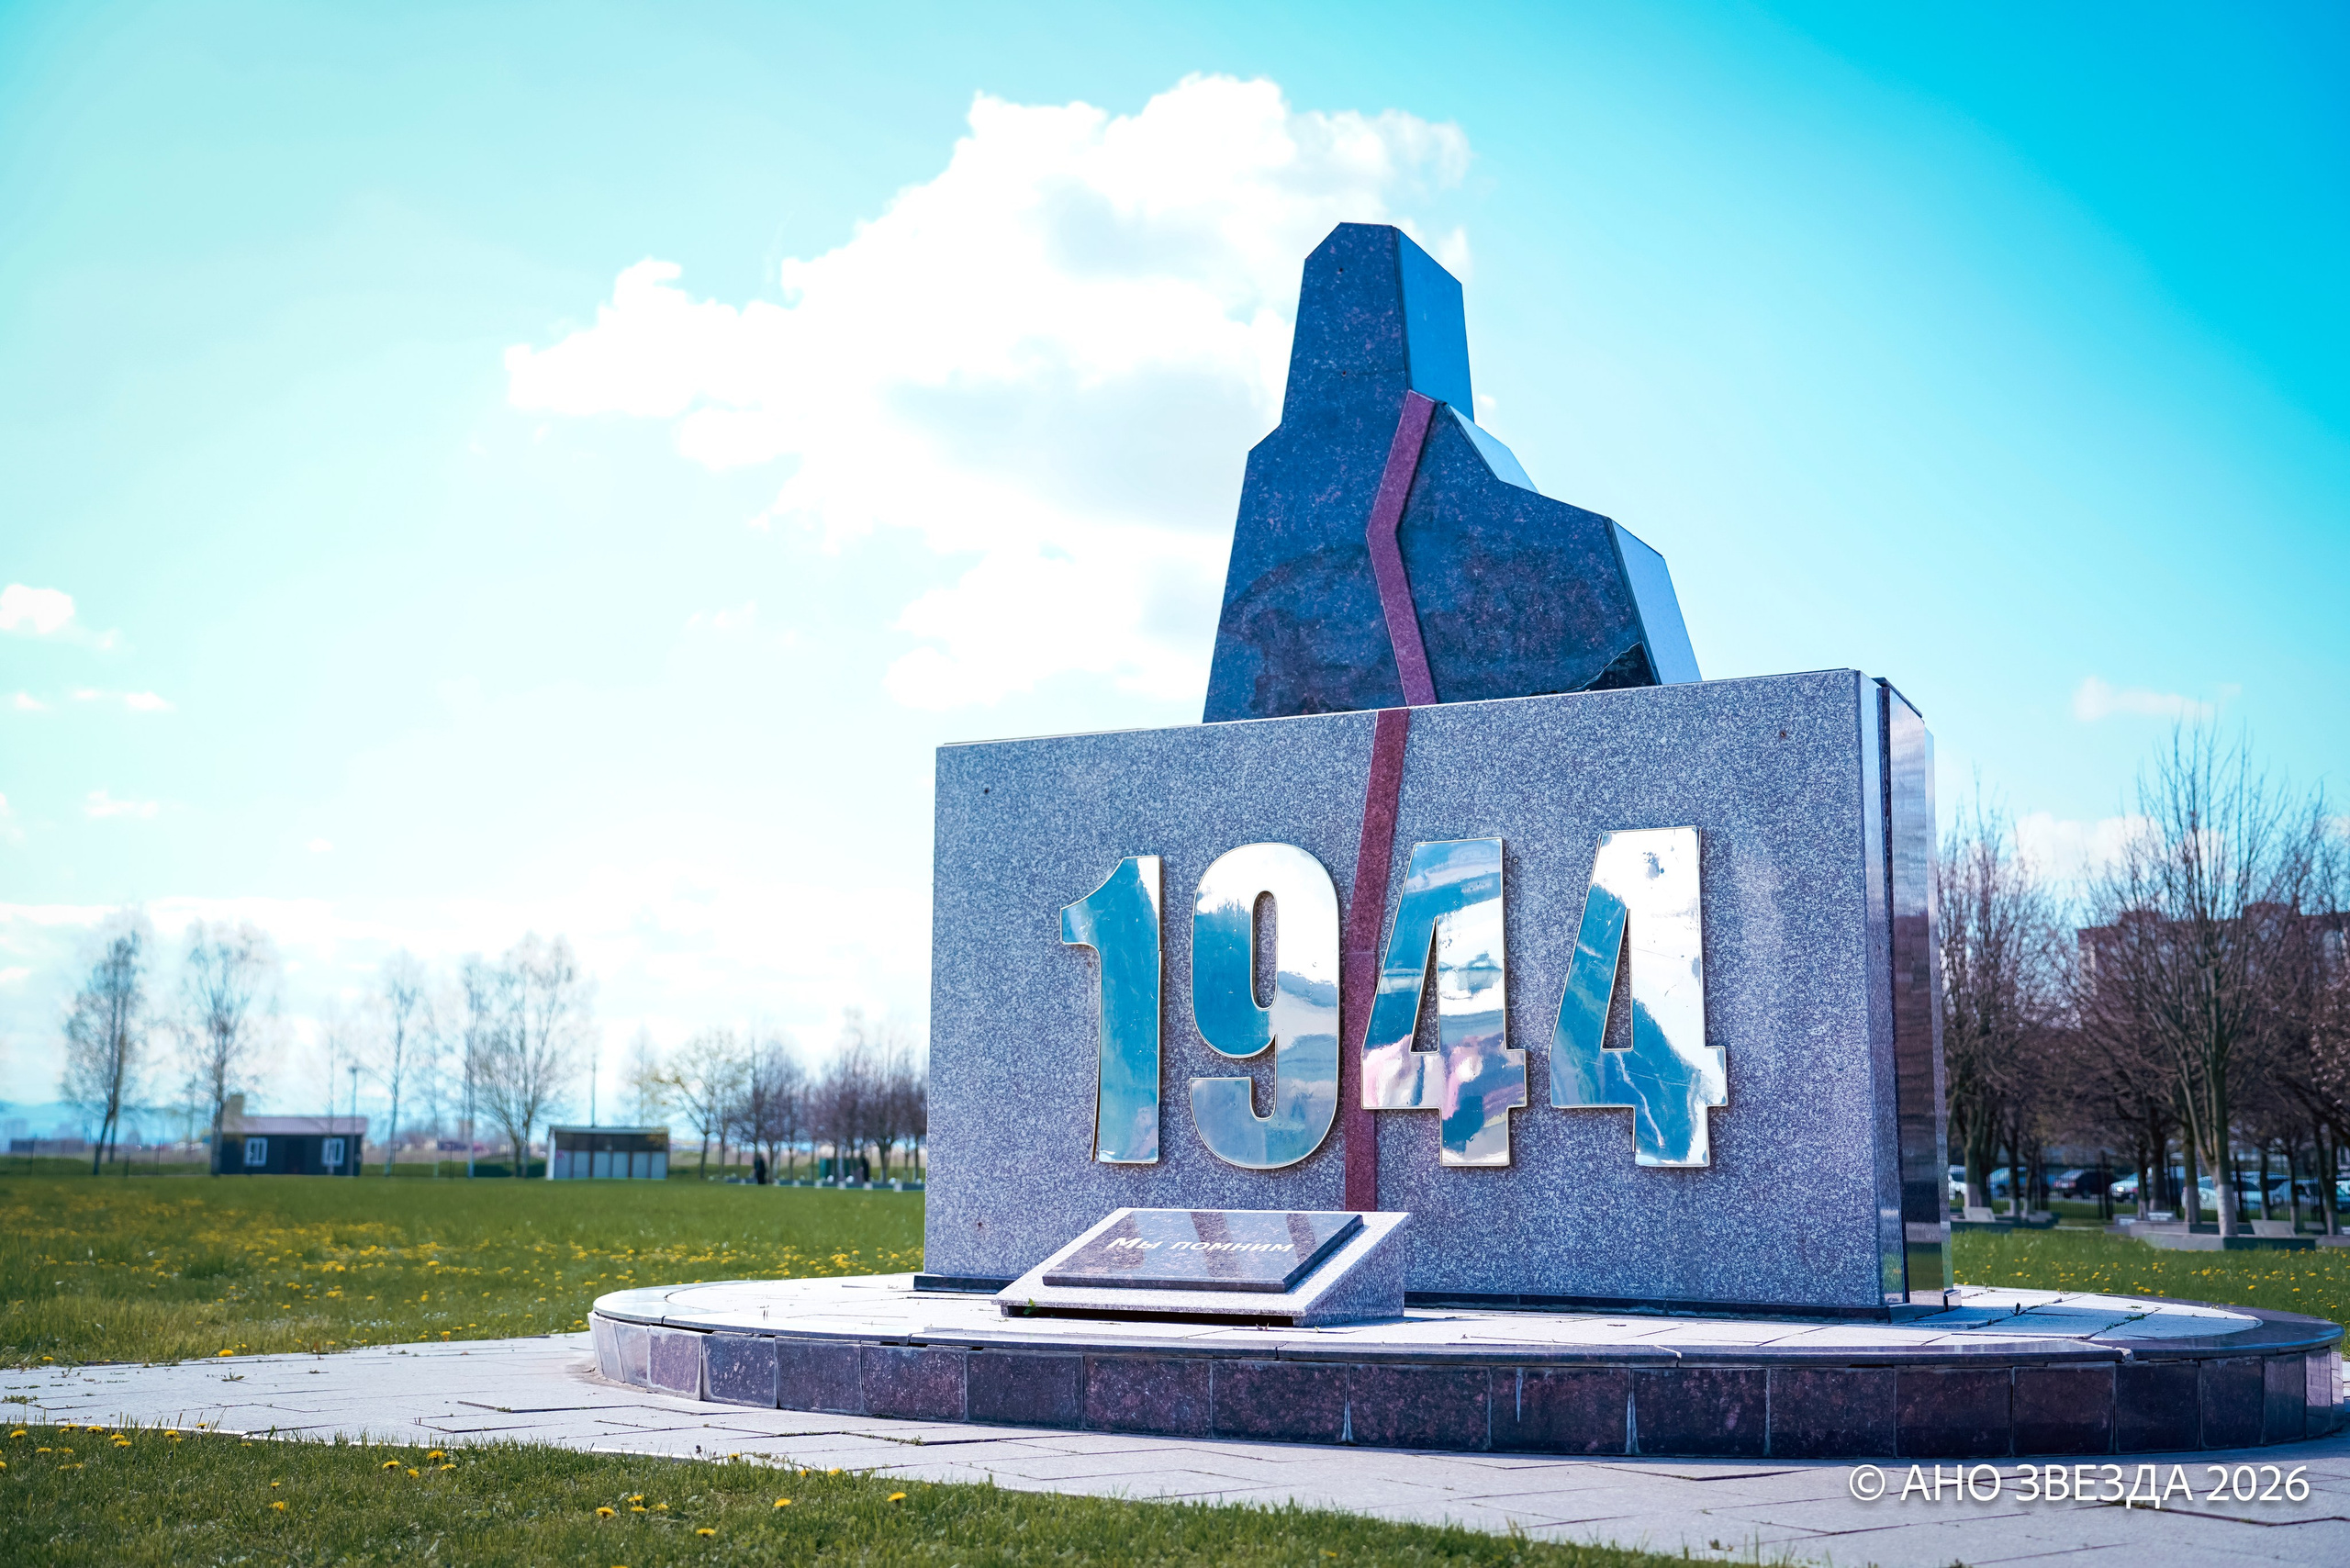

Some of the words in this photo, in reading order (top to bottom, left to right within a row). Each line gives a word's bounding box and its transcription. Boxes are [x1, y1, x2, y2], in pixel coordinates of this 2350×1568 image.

[1060, 826, 1728, 1170] 1944
[1105, 1237, 1162, 1250] Мы
[1169, 1241, 1295, 1252] помним
